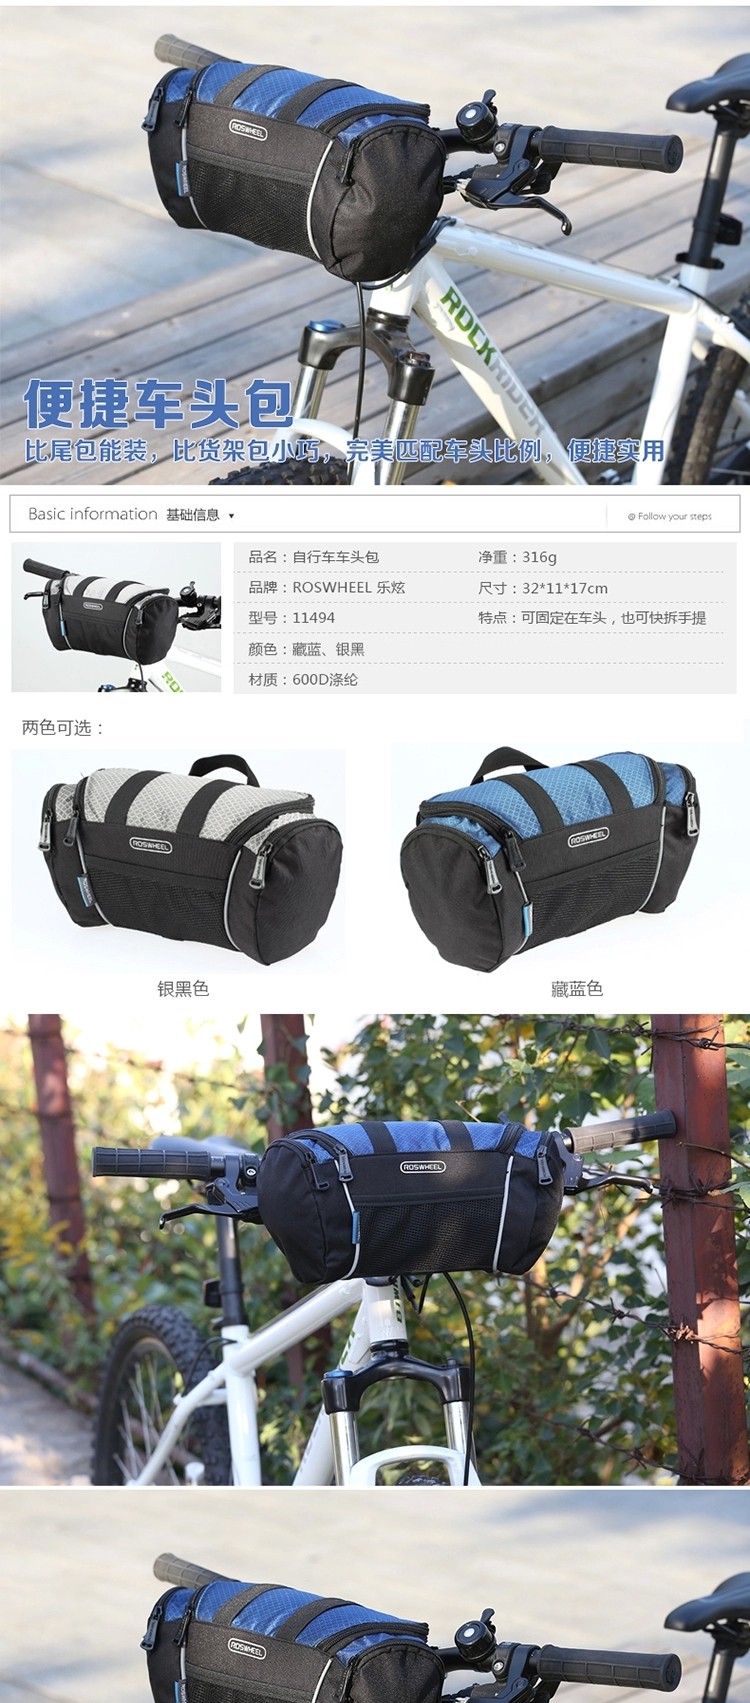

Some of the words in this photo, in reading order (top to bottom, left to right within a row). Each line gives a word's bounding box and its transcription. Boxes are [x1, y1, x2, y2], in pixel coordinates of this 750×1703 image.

[231, 122, 264, 138] ROSWHEEL
[132, 839, 170, 851] ROSWHEEL
[570, 830, 606, 846] ROSWHEEL
[403, 1163, 443, 1171] ROSWHEEL
[230, 1641, 263, 1656] ROSWHEEL
